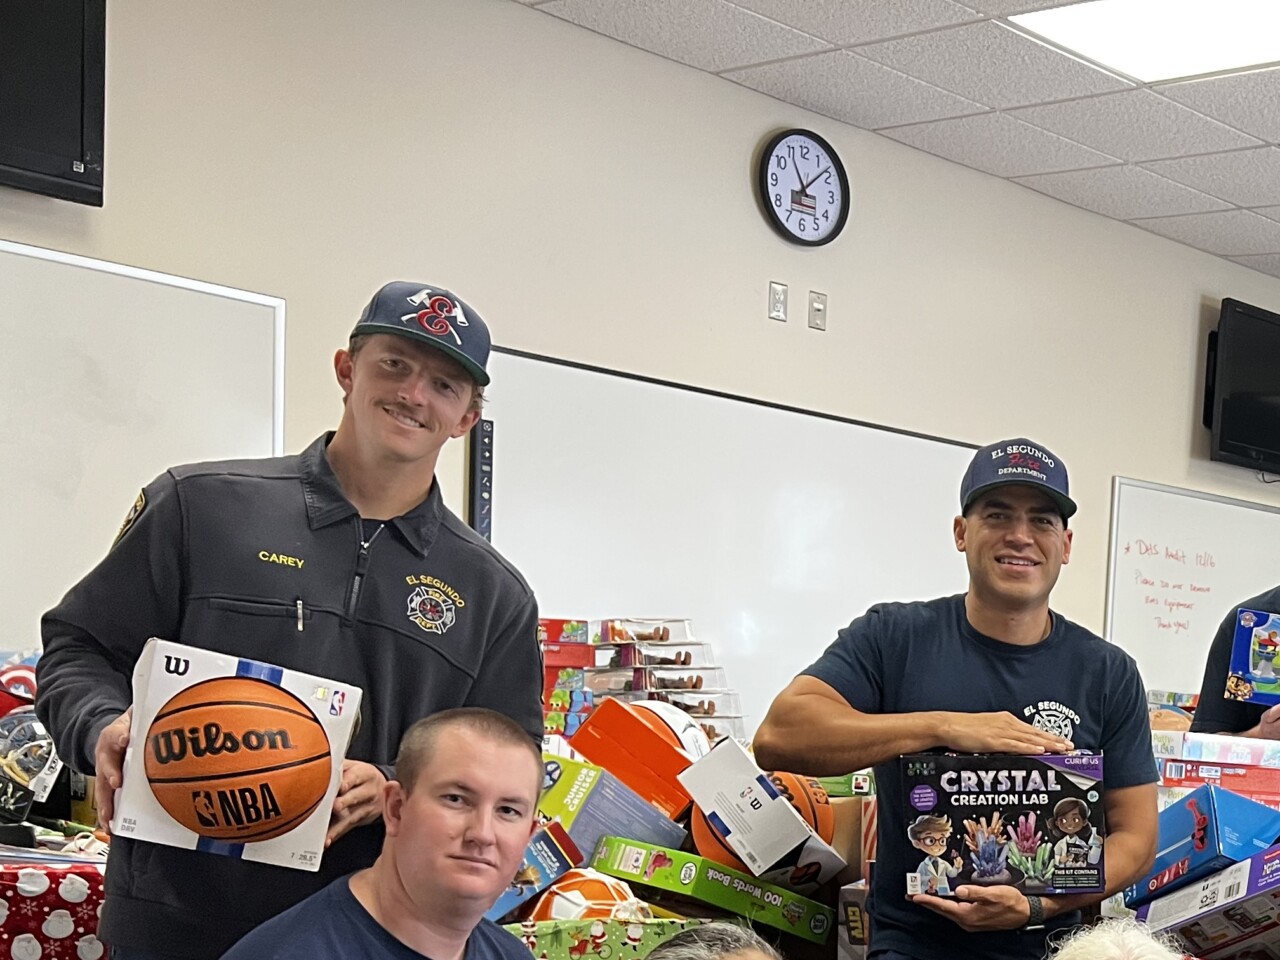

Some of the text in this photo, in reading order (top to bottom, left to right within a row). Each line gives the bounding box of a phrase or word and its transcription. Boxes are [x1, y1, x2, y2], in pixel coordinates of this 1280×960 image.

[799, 145, 809, 160] 12
[775, 155, 787, 170] 10
[816, 155, 820, 168] 1
[770, 172, 778, 187] 9
[824, 169, 831, 185] 2
[775, 193, 782, 207] 8
[828, 191, 834, 204] 3
[785, 209, 792, 222] 7
[822, 209, 829, 222] 4
[798, 218, 805, 232] 6
[813, 217, 819, 231] 5
[991, 445, 1055, 468] EL SEGUNDO
[998, 467, 1047, 481] DEPARTMENT
[258, 550, 305, 569] CAREY
[405, 574, 465, 608] EL SEGUNDO
[1023, 700, 1081, 725] EL SEGUNDO
[152, 722, 294, 765] Wilson
[1153, 745, 1175, 755] ILLAR
[563, 767, 590, 806] JUNIOR
[940, 770, 1061, 792] CRYSTAL
[568, 770, 597, 812] CRUISER
[216, 783, 283, 828] NBA
[950, 794, 1049, 806] CREATION LAB
[706, 867, 731, 887] Book
[732, 878, 764, 899] Words
[763, 891, 783, 906] 100
[847, 906, 864, 939] CITY
